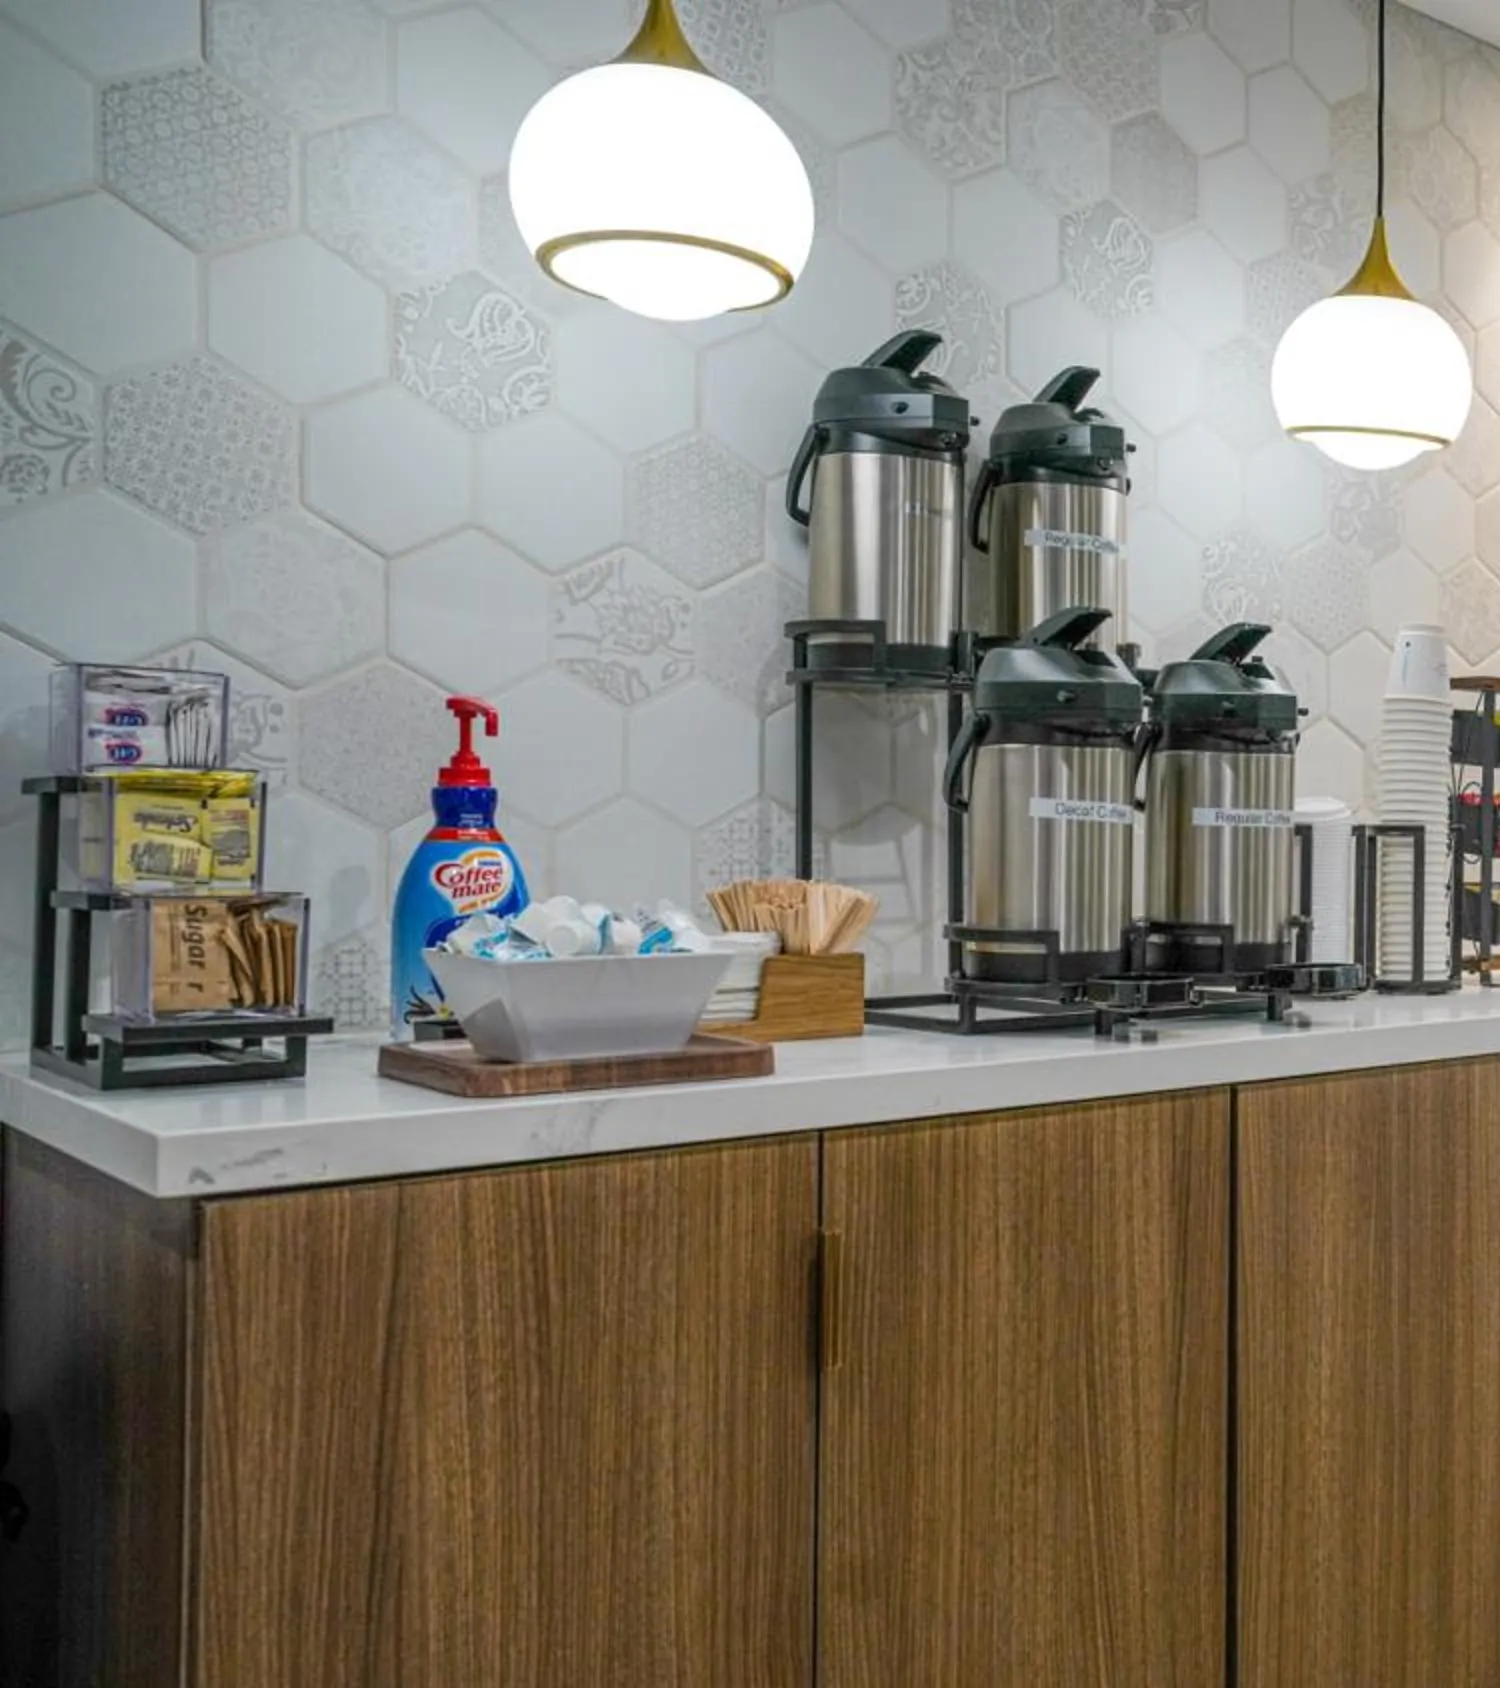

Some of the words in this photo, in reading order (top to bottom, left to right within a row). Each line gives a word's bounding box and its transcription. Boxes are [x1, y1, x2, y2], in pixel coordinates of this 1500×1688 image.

[1044, 531, 1090, 547] Regar
[435, 863, 503, 888] Coffee
[452, 881, 503, 899] mate
[182, 903, 208, 970] Sugar
